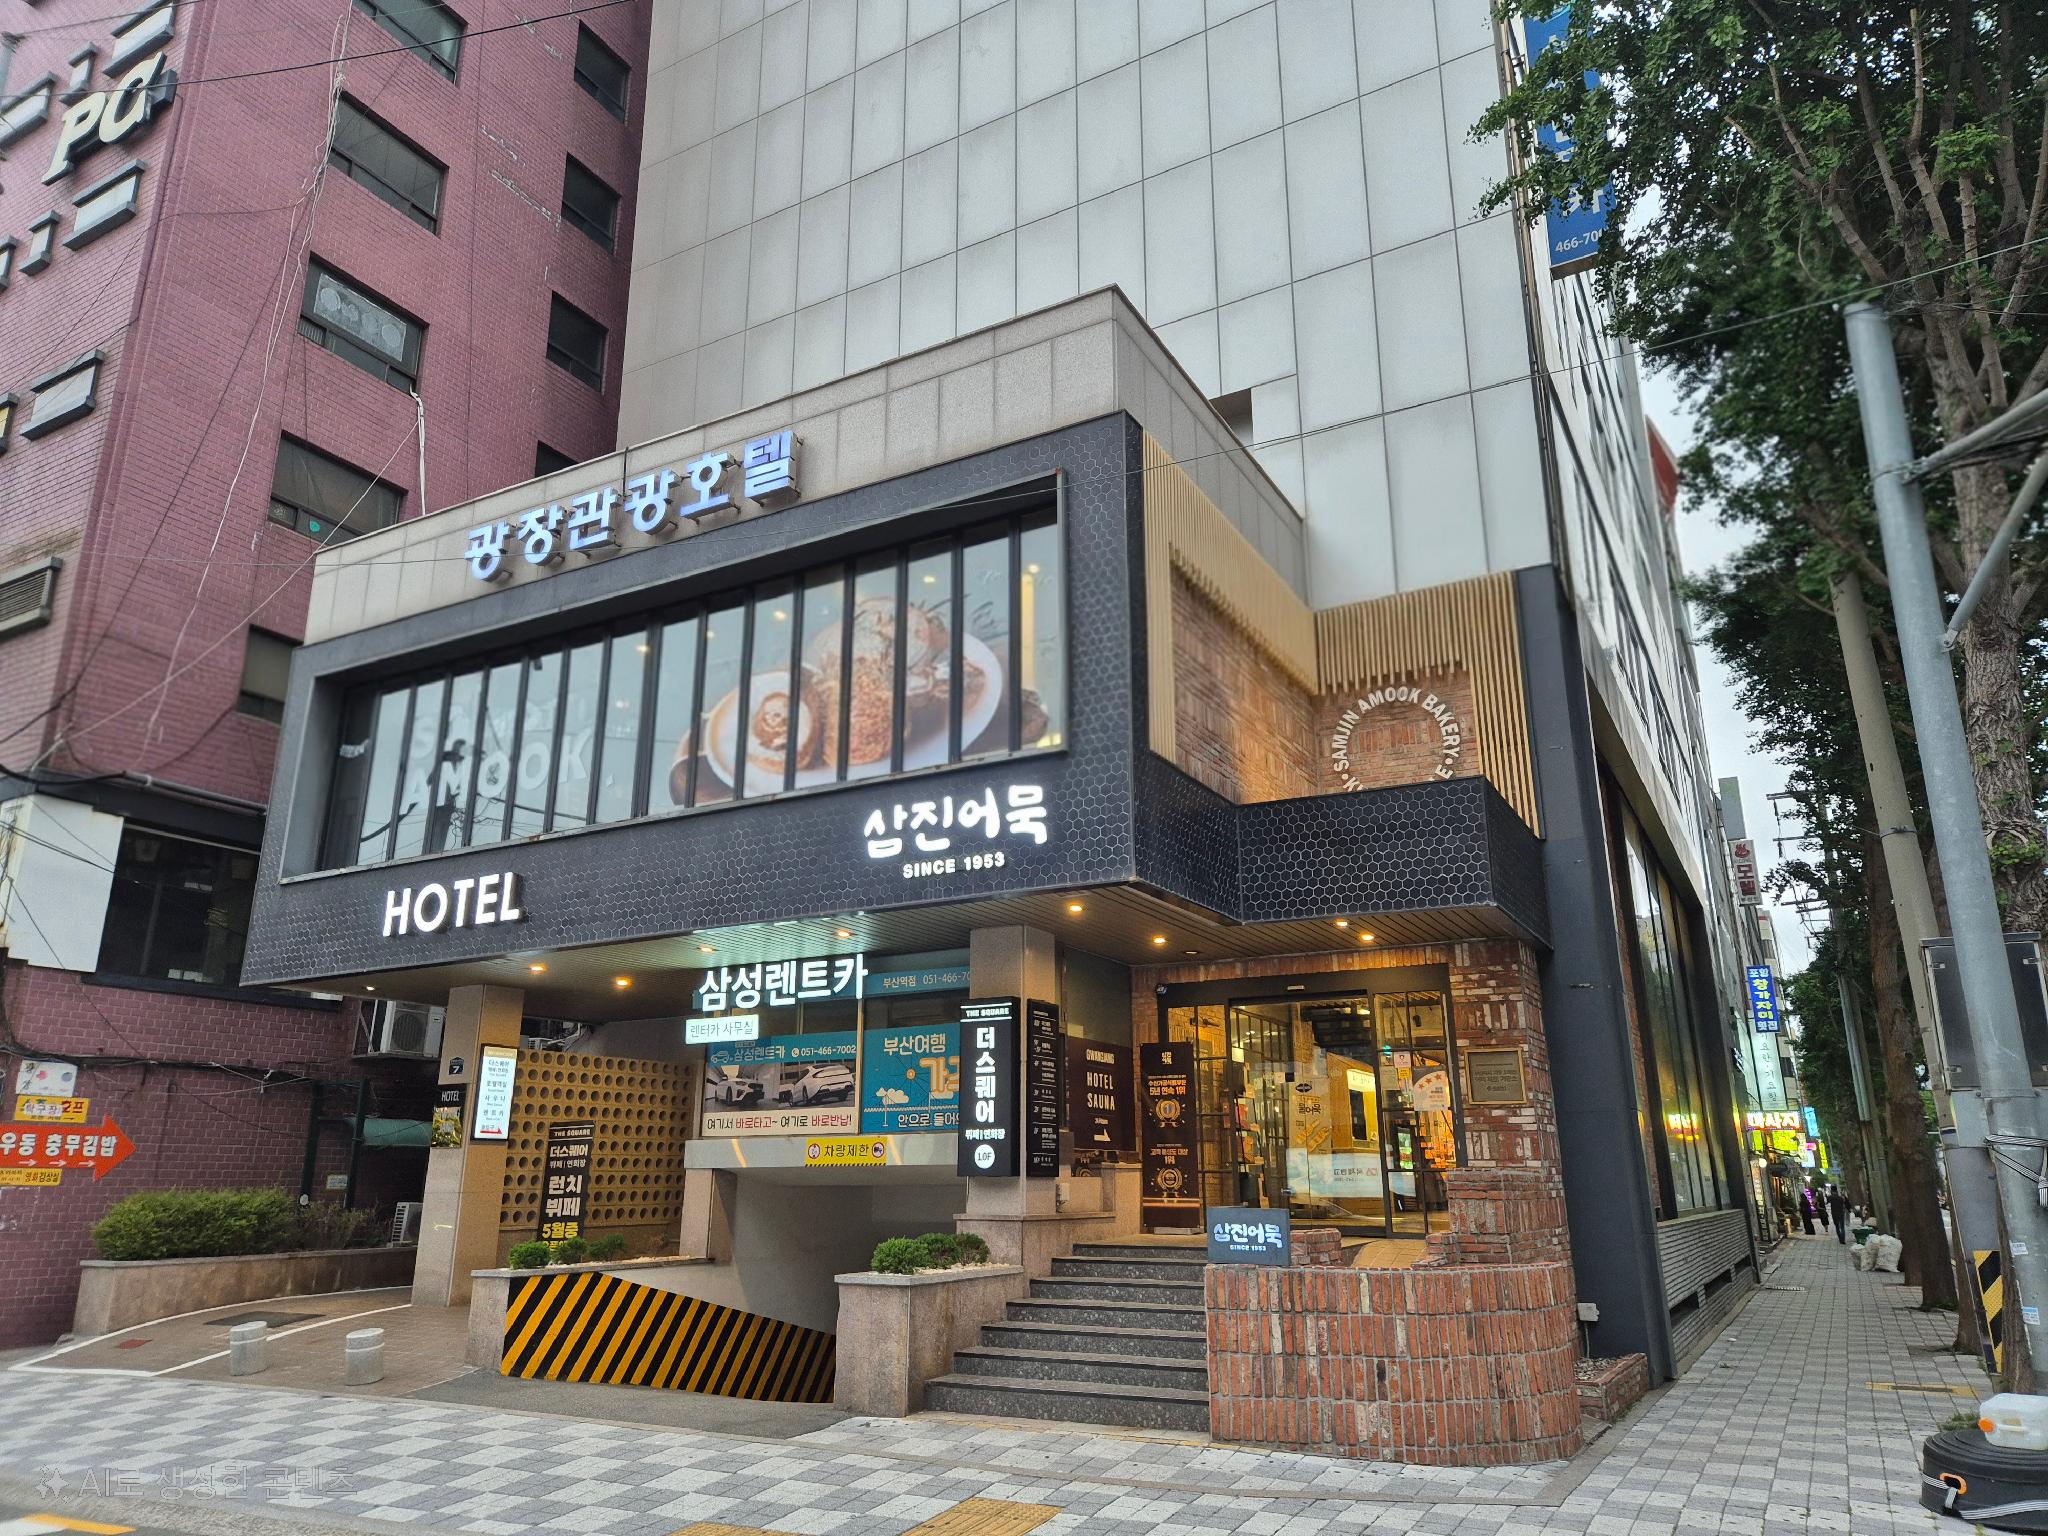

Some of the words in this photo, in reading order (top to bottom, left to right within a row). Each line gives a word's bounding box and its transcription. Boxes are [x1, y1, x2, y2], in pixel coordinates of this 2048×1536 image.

[464, 430, 796, 582] 광장관광호텔
[1332, 709, 1360, 771] SAMJIN
[1357, 686, 1421, 714] AMOOK
[1421, 694, 1461, 757] BAKERY
[863, 784, 1048, 859] 삼진어묵
[902, 858, 956, 879] SINCE
[964, 851, 1005, 871] 1953
[1736, 863, 1757, 896] 모텔
[382, 871, 522, 936] HOTEL
[698, 953, 869, 1012] 삼성렌트카
[883, 975, 917, 988] 부산역점
[966, 1009, 980, 1017] THE
[981, 1007, 1010, 1017] SQUARE
[690, 1024, 720, 1038] 렌터카
[722, 1020, 753, 1036] 사무실
[734, 1045, 786, 1062] 삼성렌트카
[800, 1044, 857, 1057] 051-466-7002
[883, 1033, 946, 1057] 부산여행
[452, 1065, 460, 1074] 7
[974, 1026, 997, 1124] 더스퀘어
[1087, 1072, 1114, 1090] HOTEL
[441, 1090, 460, 1102] HOTEL
[1087, 1093, 1116, 1111] SAUNA
[707, 1117, 734, 1130] 여기서
[735, 1116, 779, 1129] 바로타고~
[780, 1114, 809, 1127] 여기로
[811, 1113, 853, 1127] 바로반납!
[898, 1113, 932, 1128] 안으로
[1746, 1111, 1800, 1129] 마사지
[566, 1129, 591, 1137] SQUARE
[965, 1129, 981, 1140] 뷔페
[983, 1128, 1006, 1140] 연회장
[0, 1132, 37, 1156] 우동
[45, 1133, 118, 1157] 충무김밥
[549, 1144, 589, 1158] 더스퀘어
[824, 1144, 870, 1158] 차량제한
[549, 1160, 563, 1169] 뷔페
[566, 1158, 586, 1169] 연회장
[977, 1151, 992, 1162] 10F
[548, 1174, 583, 1195] 런치
[545, 1197, 580, 1218] 뷔페
[1213, 1222, 1283, 1249] 삼진어묵
